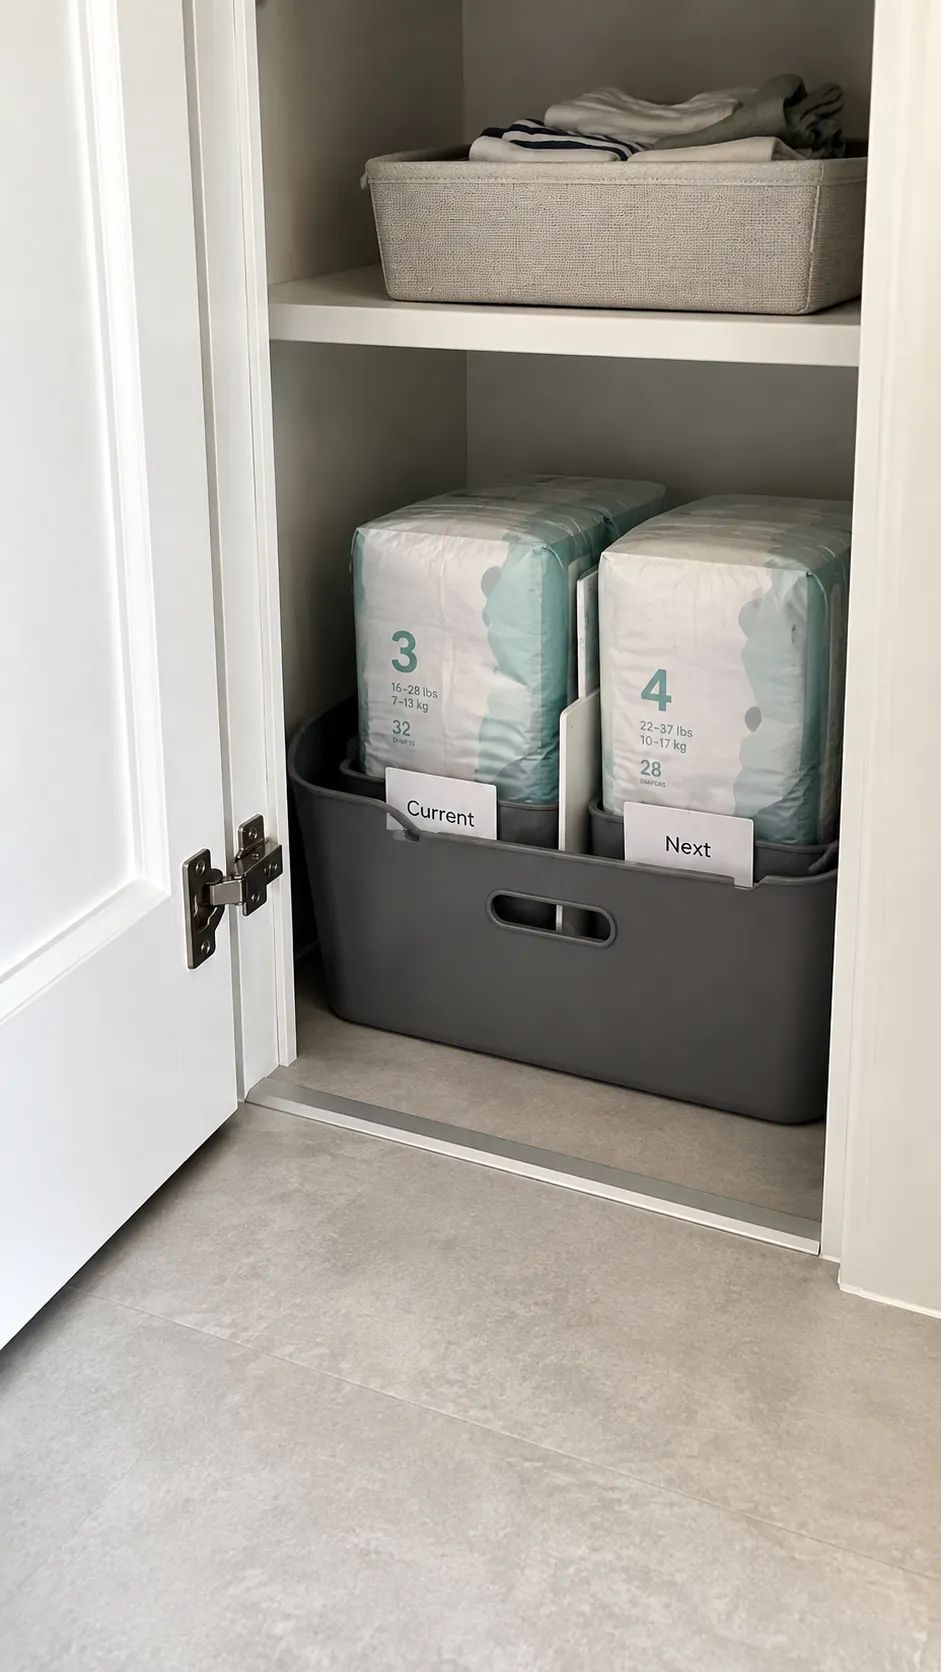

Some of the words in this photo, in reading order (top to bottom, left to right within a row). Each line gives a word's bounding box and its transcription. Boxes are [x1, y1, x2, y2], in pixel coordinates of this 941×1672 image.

[391, 630, 418, 673] 3
[391, 682, 421, 696] 16-28
[423, 686, 438, 699] lbs
[640, 668, 672, 712] 4
[391, 695, 414, 709] 7-13
[416, 699, 429, 713] kg
[392, 719, 411, 736] 32
[640, 720, 674, 735] 22-37
[676, 725, 693, 738] lbs
[640, 735, 671, 749] 10-17
[673, 739, 687, 754] kg
[640, 759, 661, 777] 28
[407, 800, 475, 827] Current
[665, 835, 711, 858] Next
